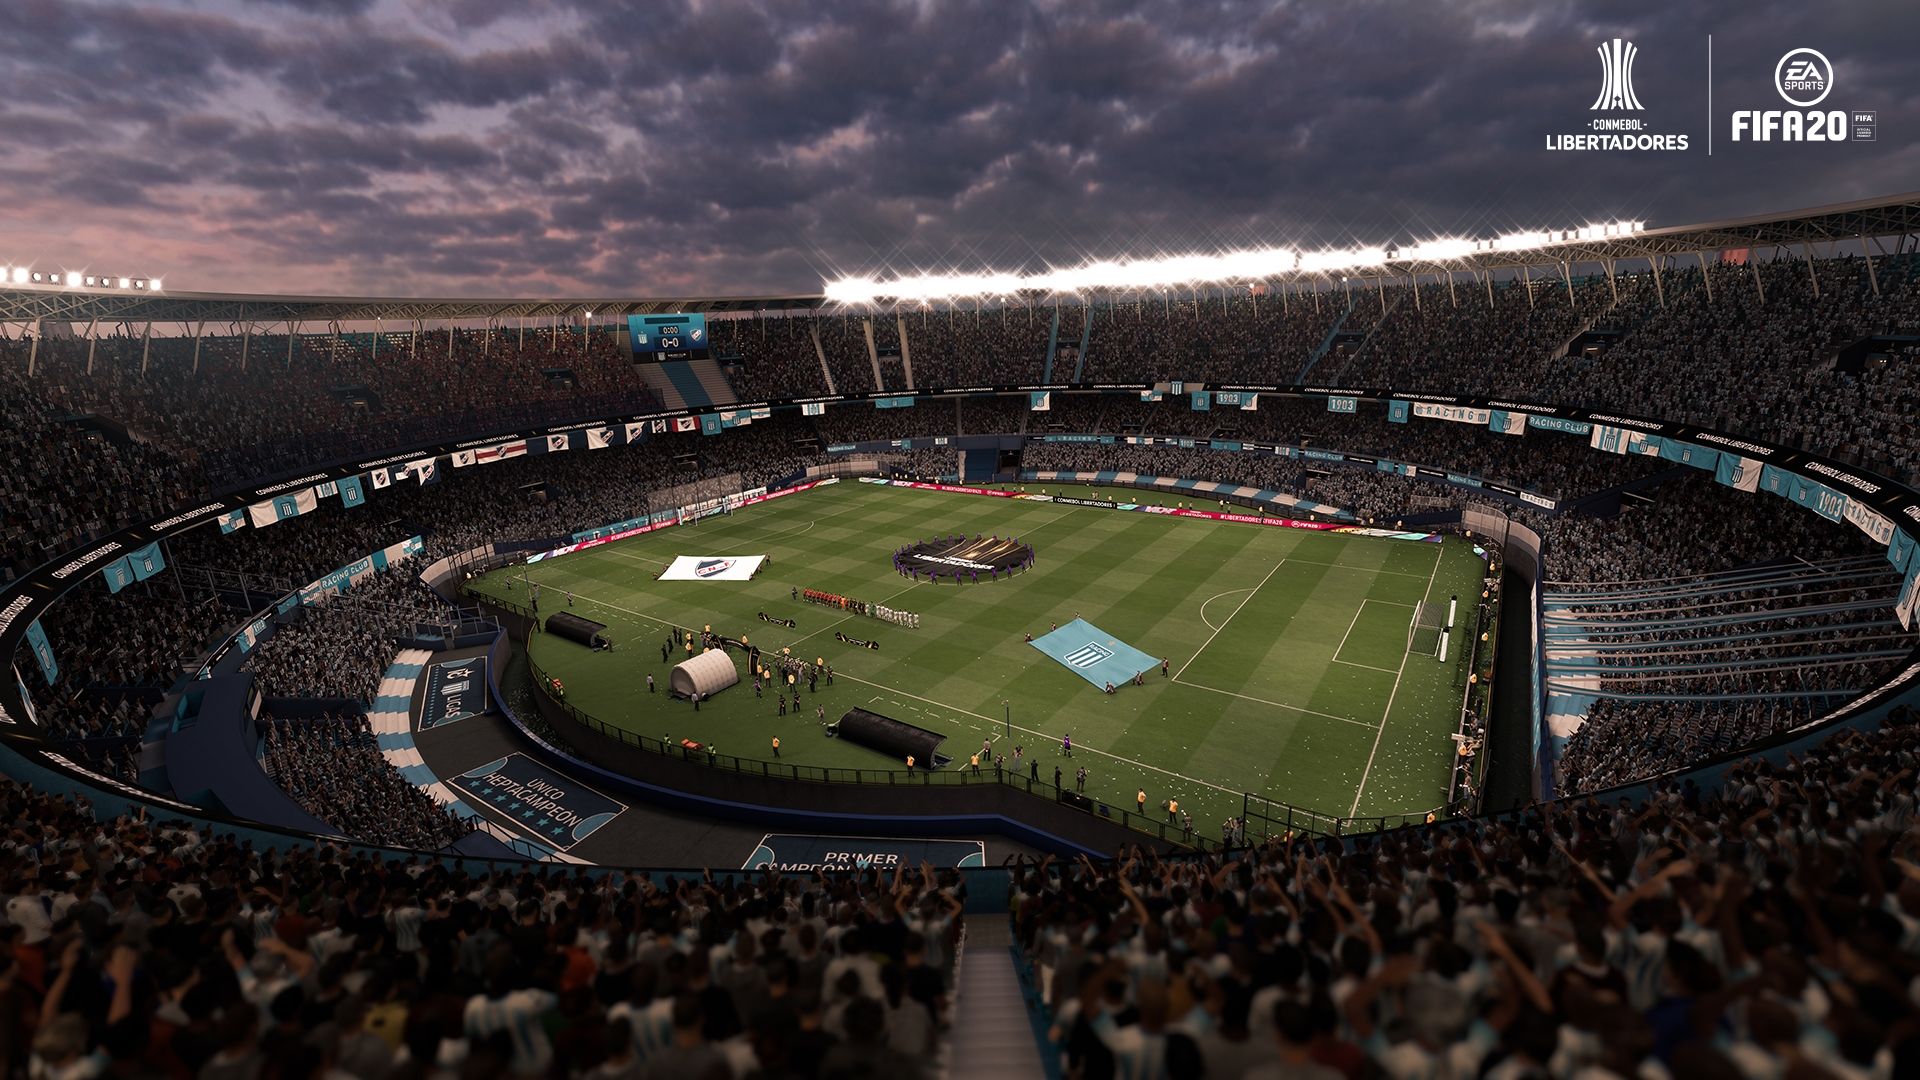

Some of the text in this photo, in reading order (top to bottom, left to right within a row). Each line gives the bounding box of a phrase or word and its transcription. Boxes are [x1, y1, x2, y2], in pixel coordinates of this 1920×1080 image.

[662, 326, 678, 334] 0:00
[662, 337, 679, 348] 0-0
[1220, 393, 1238, 402] 1903
[1331, 399, 1353, 410] 1903
[1426, 406, 1474, 420] RACING
[1529, 416, 1589, 434] RACING CLUB
[1057, 497, 1113, 508] CONMEBOL LIBERTADORES
[1818, 491, 1843, 517] 1903
[1850, 505, 1882, 535] RACING
[322, 560, 368, 588] RACING CLUB
[445, 694, 461, 719] LIGAS
[527, 777, 565, 800] ÚNICO
[482, 772, 583, 827] HEPTACAMPEÓN
